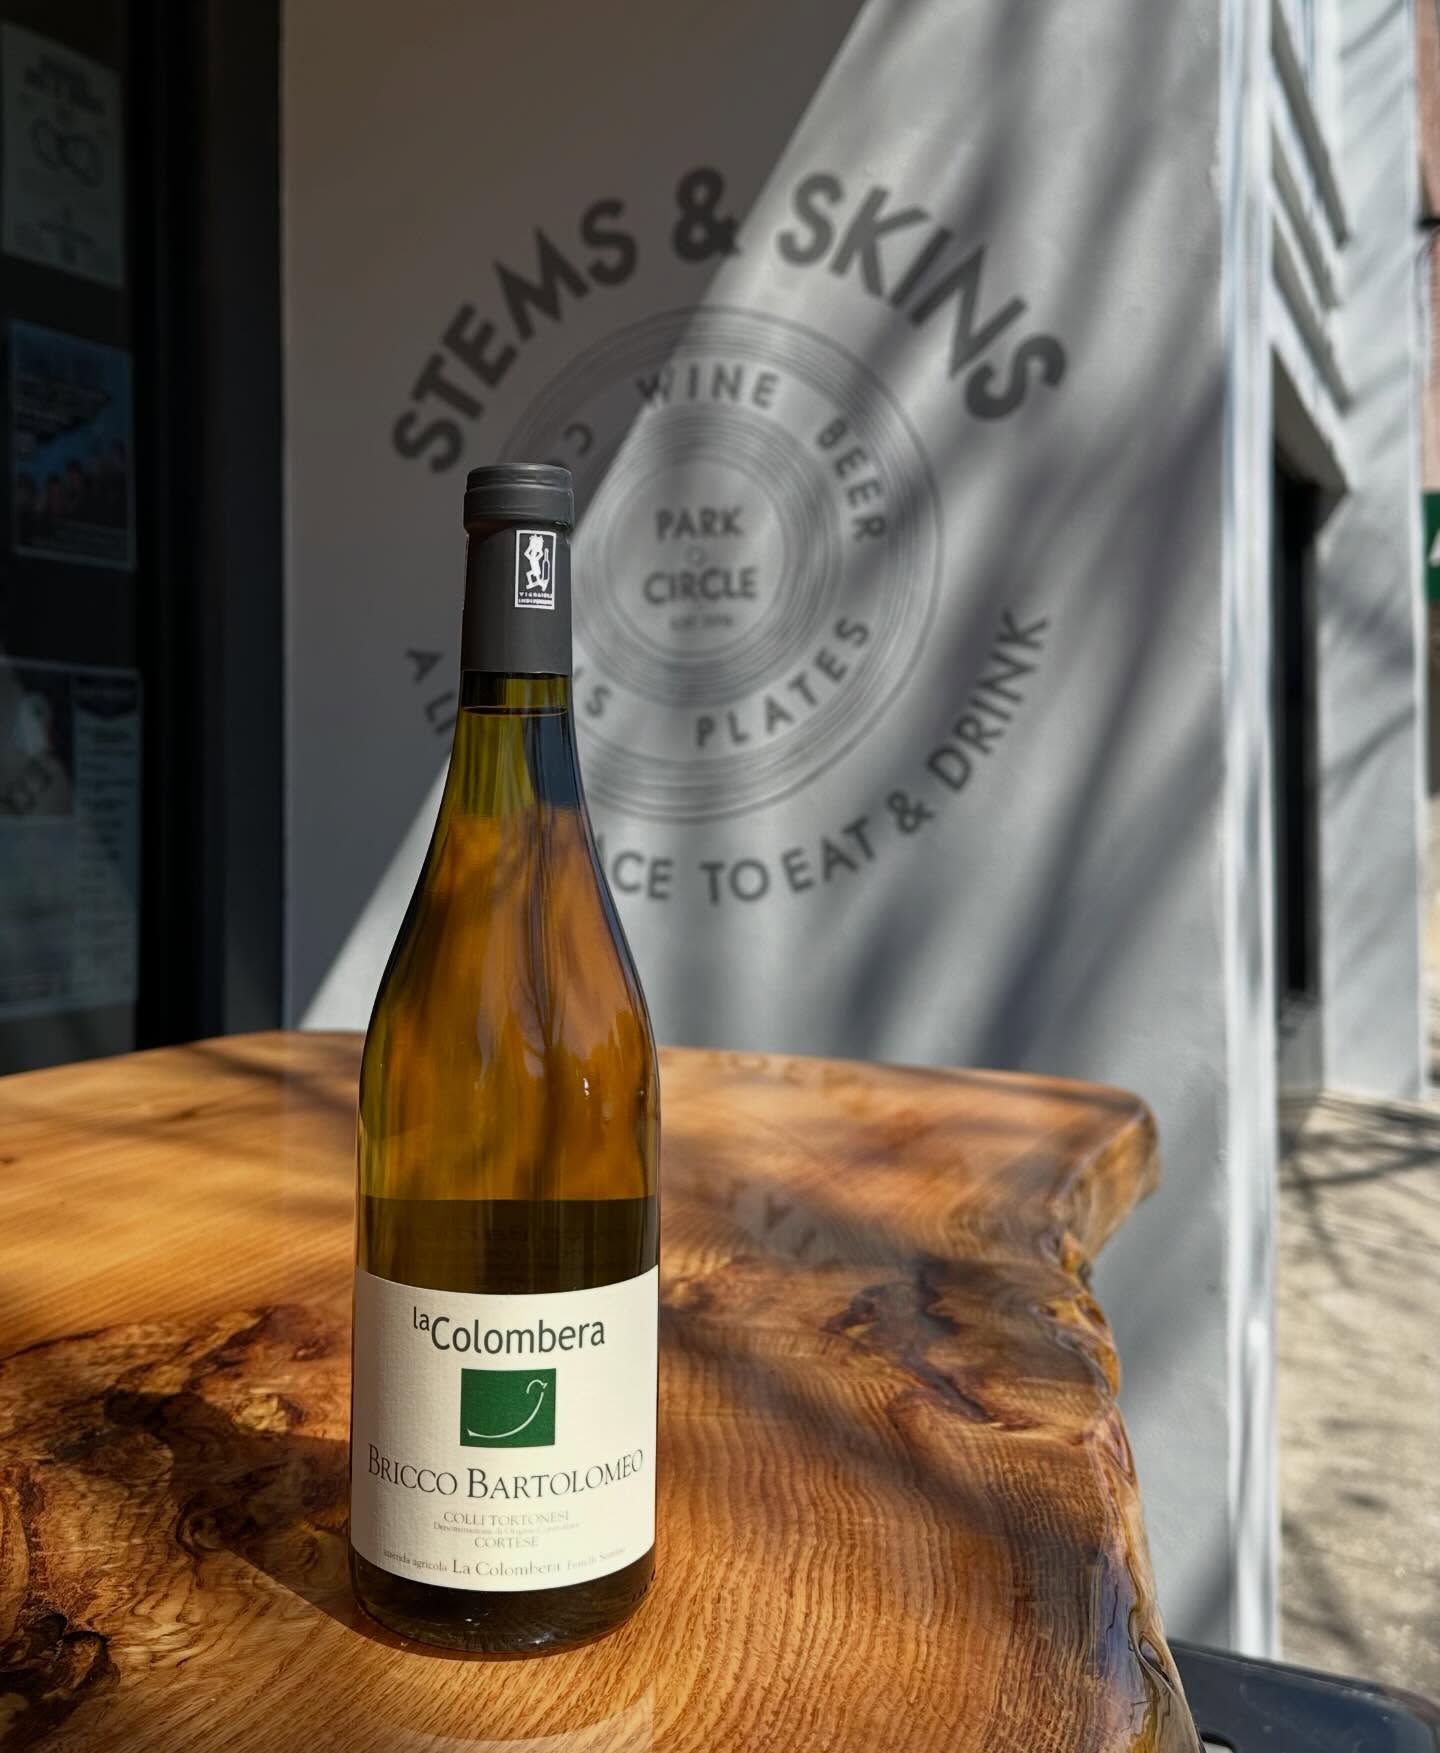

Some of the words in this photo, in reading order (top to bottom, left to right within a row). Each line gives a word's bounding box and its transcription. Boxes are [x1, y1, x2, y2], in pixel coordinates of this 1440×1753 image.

[392, 197, 637, 473] STEMS
[672, 166, 741, 263] &
[776, 171, 1068, 423] SKINS
[635, 363, 781, 409] WINE
[816, 416, 887, 543] BEER
[656, 507, 743, 541] PARK
[643, 566, 757, 605] CIRCLE
[696, 616, 870, 748] PLATES
[405, 649, 444, 684] A
[700, 859, 771, 905] TO
[782, 819, 879, 894] EAT
[889, 790, 936, 835] &
[927, 609, 1050, 792] DRINK
[367, 1443, 457, 1496] BRICCO
[467, 1448, 643, 1500] BARTOLOMEO
[443, 1511, 485, 1526] COLLI
[487, 1509, 569, 1526] TORTONESI
[474, 1535, 539, 1549] CORTESE
[453, 1559, 470, 1575] La
[475, 1560, 560, 1577] Colombera
